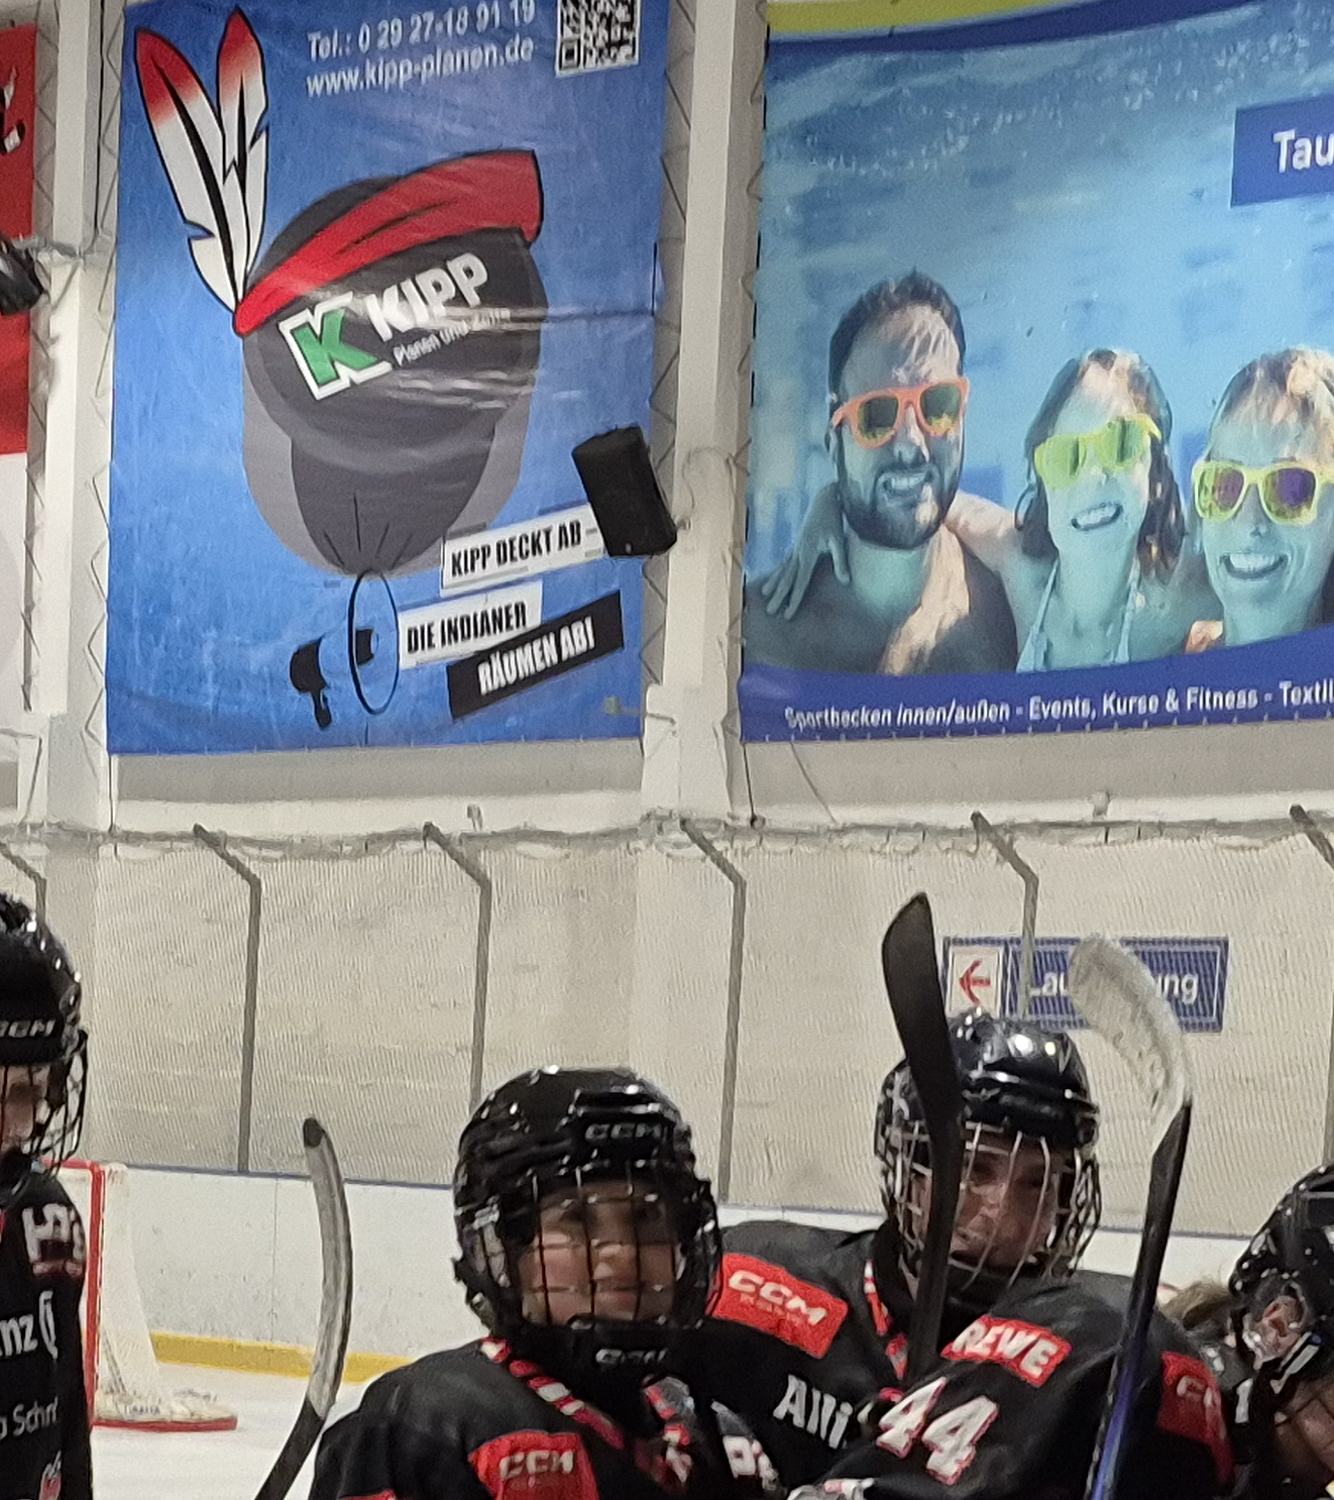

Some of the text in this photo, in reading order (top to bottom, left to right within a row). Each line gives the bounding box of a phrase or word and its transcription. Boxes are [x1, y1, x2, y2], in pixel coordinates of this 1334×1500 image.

[306, 33, 535, 98] www.kipp-planen.de
[307, 28, 351, 62] Tel.:
[358, 22, 370, 53] 0
[377, 17, 403, 50] 29
[363, 252, 489, 343] KIPP
[451, 518, 582, 578] KIPP DECKT AB
[407, 600, 528, 655] DIE INDIANER
[477, 632, 558, 697] RÄUMEN
[783, 704, 892, 733] Sportbecken
[1028, 693, 1097, 722] Events,
[1103, 690, 1160, 718] Kurse
[1165, 687, 1180, 712] &
[1186, 685, 1259, 711] Fitness
[584, 1119, 666, 1142] CCM
[727, 1268, 829, 1327] CCM
[950, 1320, 1059, 1378] REWE
[773, 1374, 853, 1452] Alli
[875, 1376, 1000, 1486] 44
[499, 1449, 575, 1482] CCM
